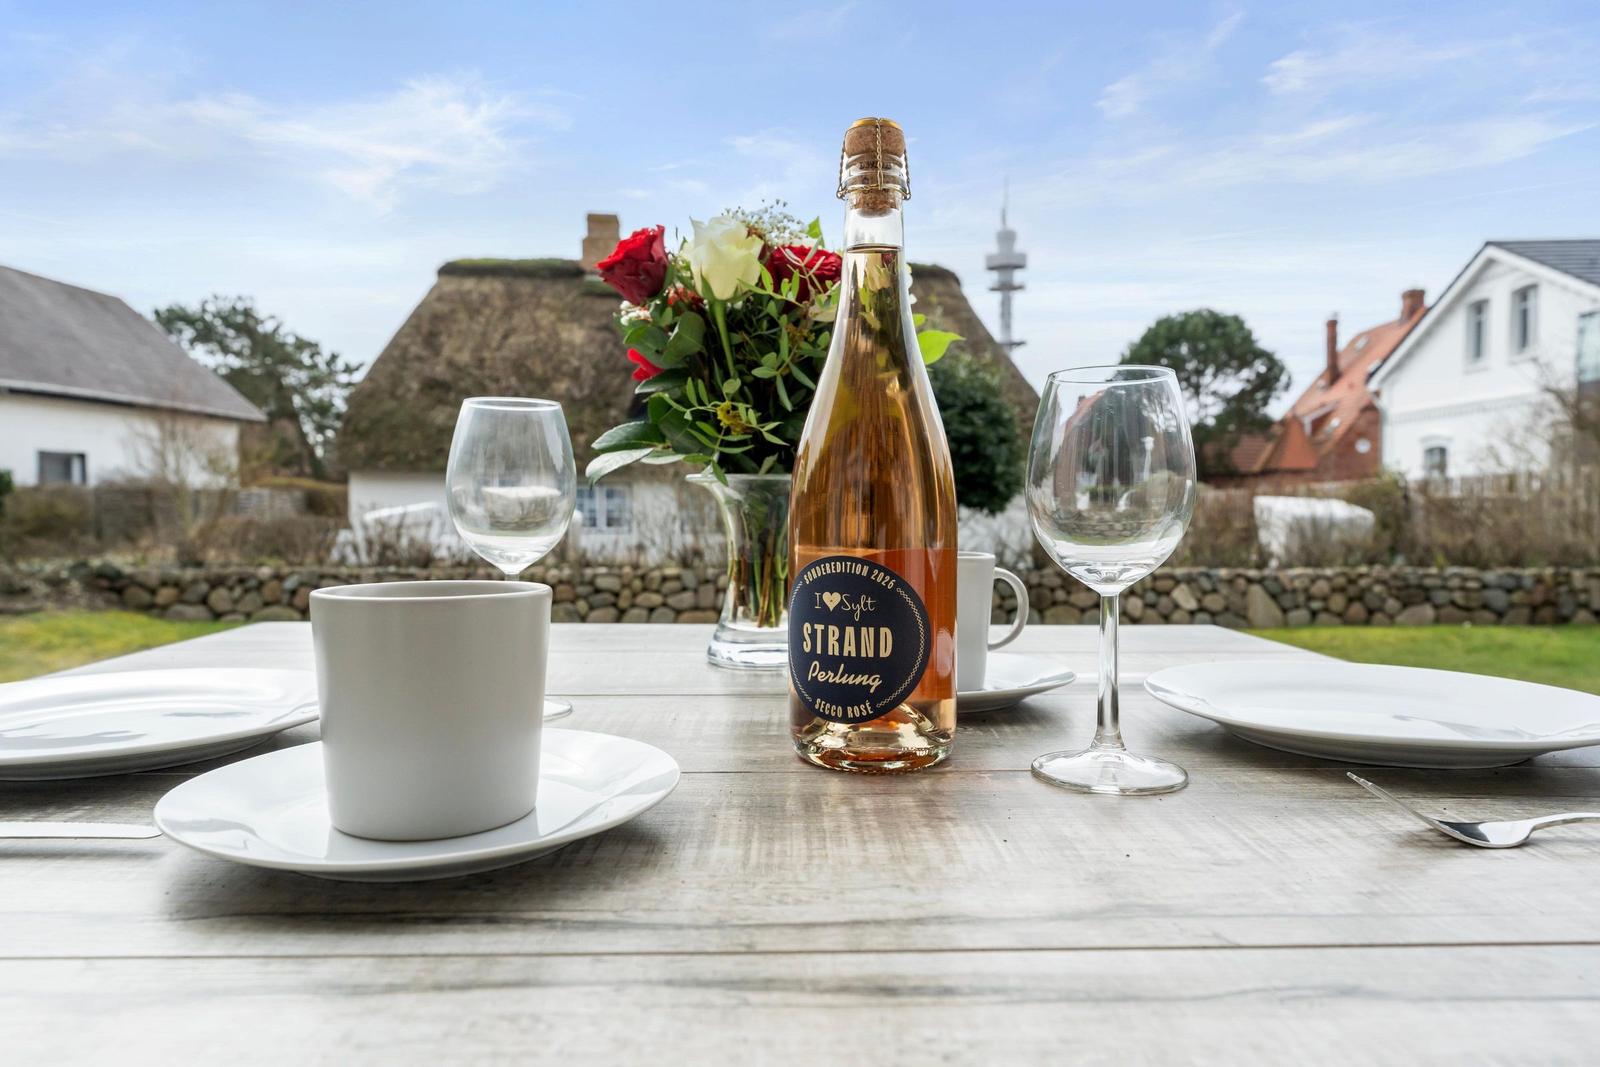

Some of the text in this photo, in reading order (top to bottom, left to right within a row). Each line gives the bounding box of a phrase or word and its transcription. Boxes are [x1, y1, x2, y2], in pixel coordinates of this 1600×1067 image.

[803, 561, 897, 590] SONDEREDITION 2026
[841, 593, 877, 621] Sylt
[802, 622, 893, 658] STRAND
[807, 660, 882, 694] Perlung
[814, 698, 874, 718] SECCO ROSÉ
